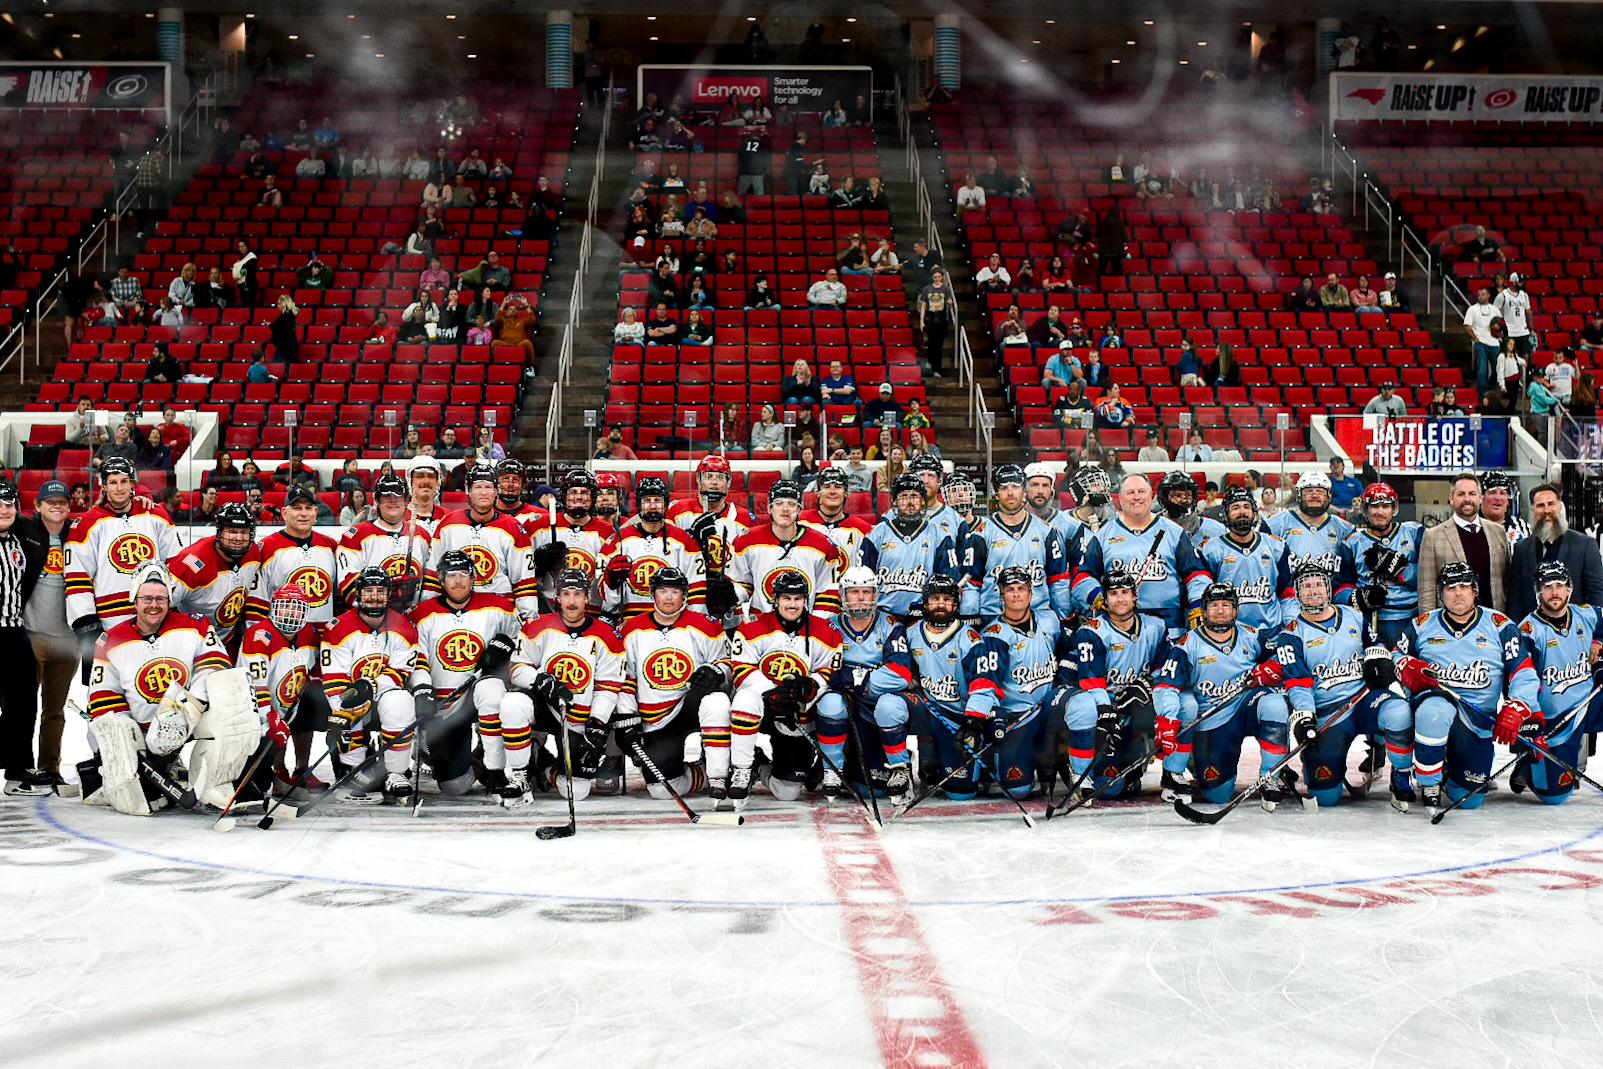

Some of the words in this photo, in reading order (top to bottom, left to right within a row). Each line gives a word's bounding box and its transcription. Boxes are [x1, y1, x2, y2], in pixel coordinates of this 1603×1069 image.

[698, 82, 761, 98] Lenovo
[774, 77, 809, 86] Smarter
[774, 86, 823, 96] technology
[774, 96, 788, 104] for
[788, 96, 798, 104] all
[1372, 422, 1438, 445] BATTLE
[1441, 422, 1465, 445] OF
[1366, 445, 1401, 467] THE
[1403, 444, 1476, 467] BADGES
[848, 532, 855, 545] A
[878, 562, 928, 588] Raleigh
[1235, 574, 1272, 600] aleigh
[589, 641, 597, 655] A
[1504, 636, 1519, 660] 26
[141, 760, 184, 800] TRUE
